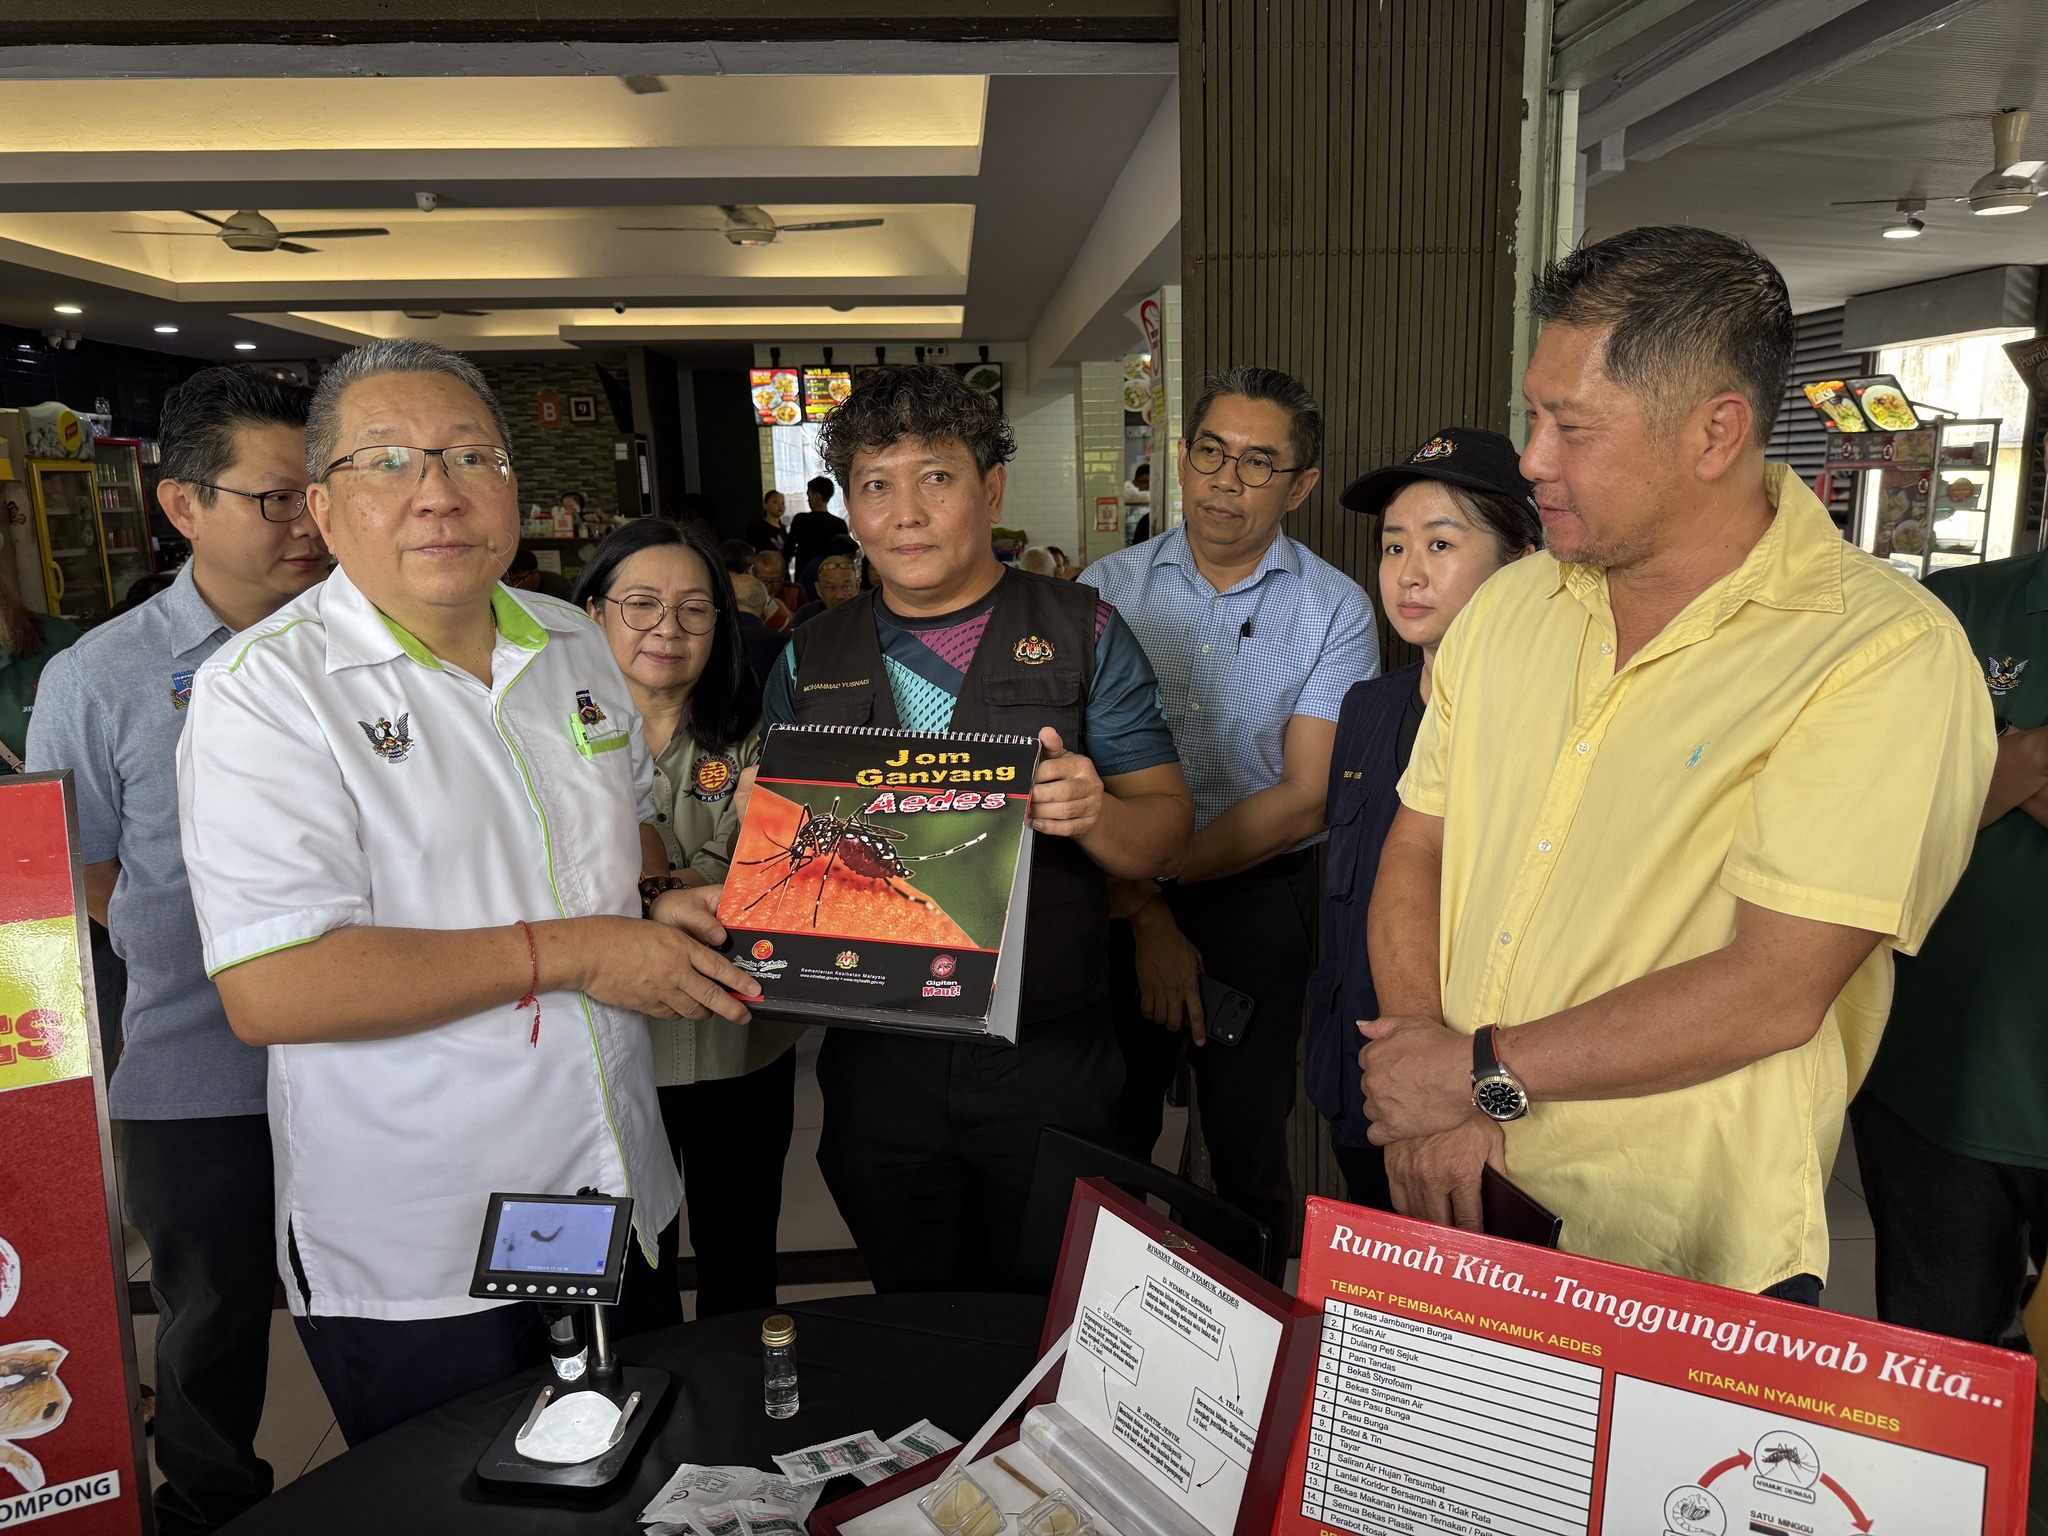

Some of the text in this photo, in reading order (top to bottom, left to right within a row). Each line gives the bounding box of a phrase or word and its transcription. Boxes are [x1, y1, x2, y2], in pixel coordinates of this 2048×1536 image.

[543, 402, 556, 421] B
[885, 749, 971, 767] Jom
[855, 766, 1016, 786] Ganyang
[864, 788, 1006, 815] Aedes
[800, 967, 834, 975] Kementerian
[922, 985, 961, 998] Maut!
[1147, 1243, 1171, 1264] RIWAYAT
[1191, 1269, 1217, 1293] NYAMUK
[1218, 1289, 1240, 1308] AEDES
[1168, 1281, 1190, 1299] NYAMUK
[1191, 1295, 1213, 1315] DEWASA
[1329, 1224, 1444, 1275] Rumah
[1877, 1350, 2003, 1408] Kita...
[1330, 1279, 1602, 1357] TEMPAT PEMBIAKAN NYAMUK AEDES
[1330, 1317, 1386, 1338] 2. Kolah Air
[1332, 1303, 1452, 1340] 1. Bekas Jambangan Bunga
[1327, 1346, 1396, 1370] 4. Pam Tandas
[1328, 1331, 1418, 1362] 3. Dulang Peti Sejuk
[1325, 1361, 1412, 1390] 5. Bekas Styrofoam
[1322, 1390, 1410, 1421] 7. Alas Pasu Bunga
[1323, 1375, 1423, 1408] 6. Bekas Simpanan Air
[1688, 1368, 1900, 1432] KITARAN NYAMUK AEDES
[1225, 1399, 1244, 1417] TELUR
[1320, 1404, 1388, 1431] 8. Pasu Bunga
[1143, 1412, 1180, 1444] JENTIK-JENTIK
[1313, 1432, 1360, 1452] 10. Tayar
[1318, 1418, 1381, 1443] 9. Botol & Tin
[1312, 1447, 1445, 1492] 11. Saliran Air Hujan Tersumbat
[0, 1478, 111, 1523] OMPONG
[1308, 1476, 1320, 1486] 13.
[1334, 1483, 1357, 1497] Bekas
[1360, 1491, 1396, 1509] Makanan
[1398, 1503, 1427, 1519] Haiwan
[1310, 1461, 1491, 1523] 12. Lantai Koridor Bersampah & Tidak Rata
[1756, 1479, 1812, 1500] NYAMUK DEWASA
[1304, 1505, 1387, 1536] 15. Perabot Rosak
[1306, 1491, 1414, 1531] 14. Semua Bekas Plastik
[1750, 1509, 1814, 1534] SATU MINGGU
